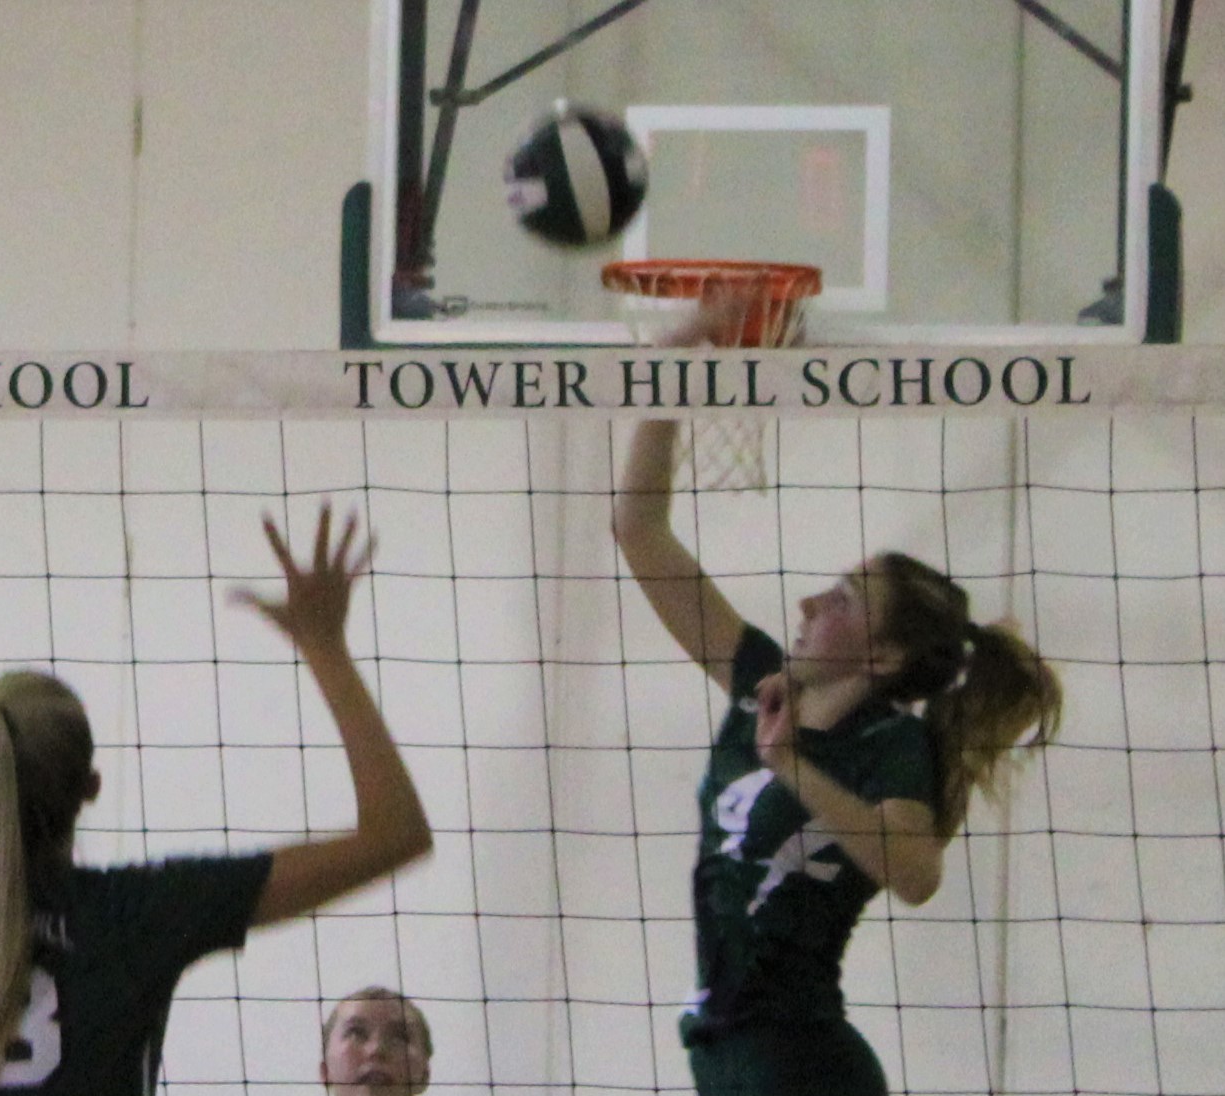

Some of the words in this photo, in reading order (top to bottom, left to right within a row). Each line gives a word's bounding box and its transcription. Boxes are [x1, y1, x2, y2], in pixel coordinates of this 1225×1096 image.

[343, 360, 596, 409] TOWER
[618, 359, 778, 408] HILL
[800, 356, 1093, 408] SCHOOL
